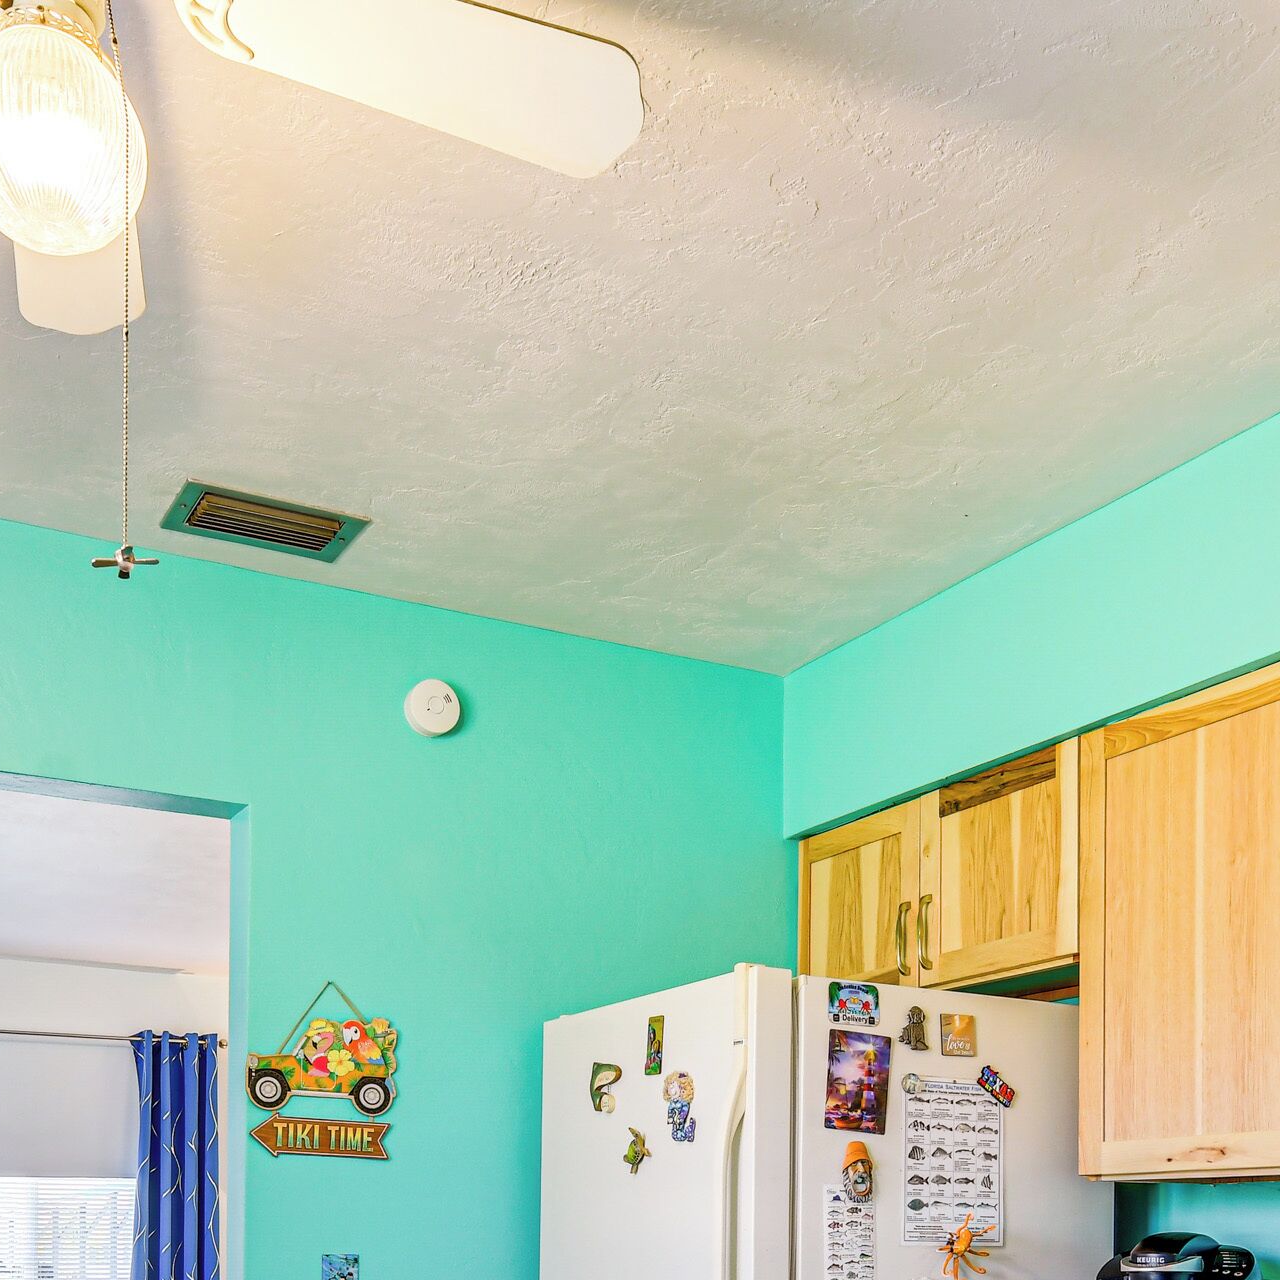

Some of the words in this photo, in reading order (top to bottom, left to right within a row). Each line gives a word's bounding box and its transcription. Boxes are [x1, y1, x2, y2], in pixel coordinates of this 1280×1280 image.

[842, 1014, 869, 1024] Delivery
[942, 1033, 965, 1051] love
[982, 1067, 1014, 1102] TEXAS
[273, 1122, 320, 1149] TIKI
[327, 1125, 375, 1152] TIME
[1136, 1256, 1165, 1264] KEURIG
